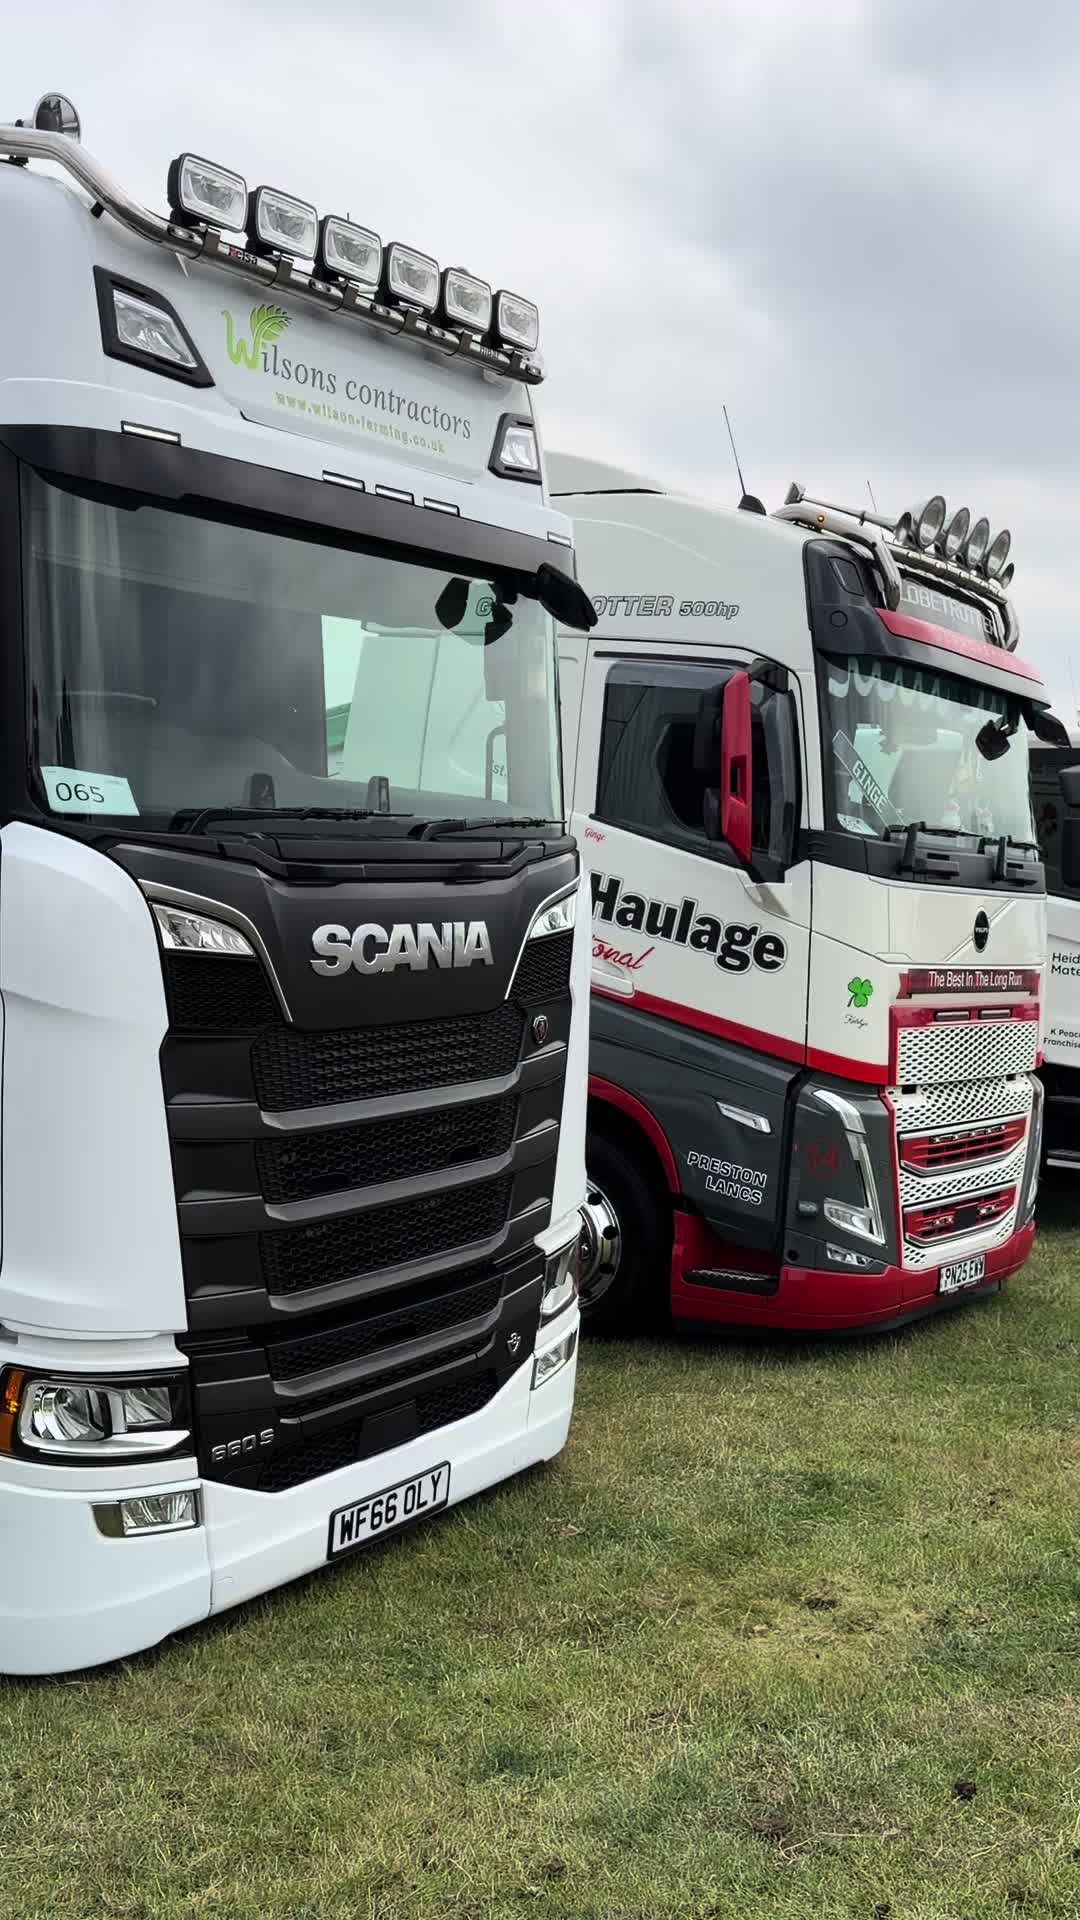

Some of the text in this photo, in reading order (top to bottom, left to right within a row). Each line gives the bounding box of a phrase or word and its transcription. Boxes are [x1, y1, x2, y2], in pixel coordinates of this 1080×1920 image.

[221, 304, 472, 439] Wilsons contractors
[590, 595, 675, 617] OTTER
[678, 600, 741, 621] 500hp
[55, 782, 105, 803] 065
[852, 759, 886, 814] GINGE
[590, 870, 788, 975] Haulage
[309, 920, 495, 977] SCANIA
[591, 941, 656, 970] onal
[1051, 952, 1080, 965] Heid
[927, 970, 1023, 990] The Best In The Long Run
[1050, 964, 1080, 976] Mate
[687, 1151, 768, 1188] PRESTON
[705, 1175, 763, 1205] LANCS
[944, 1262, 968, 1288] PN25
[260, 1428, 274, 1446] S
[340, 1470, 442, 1545] WF66 OLY
